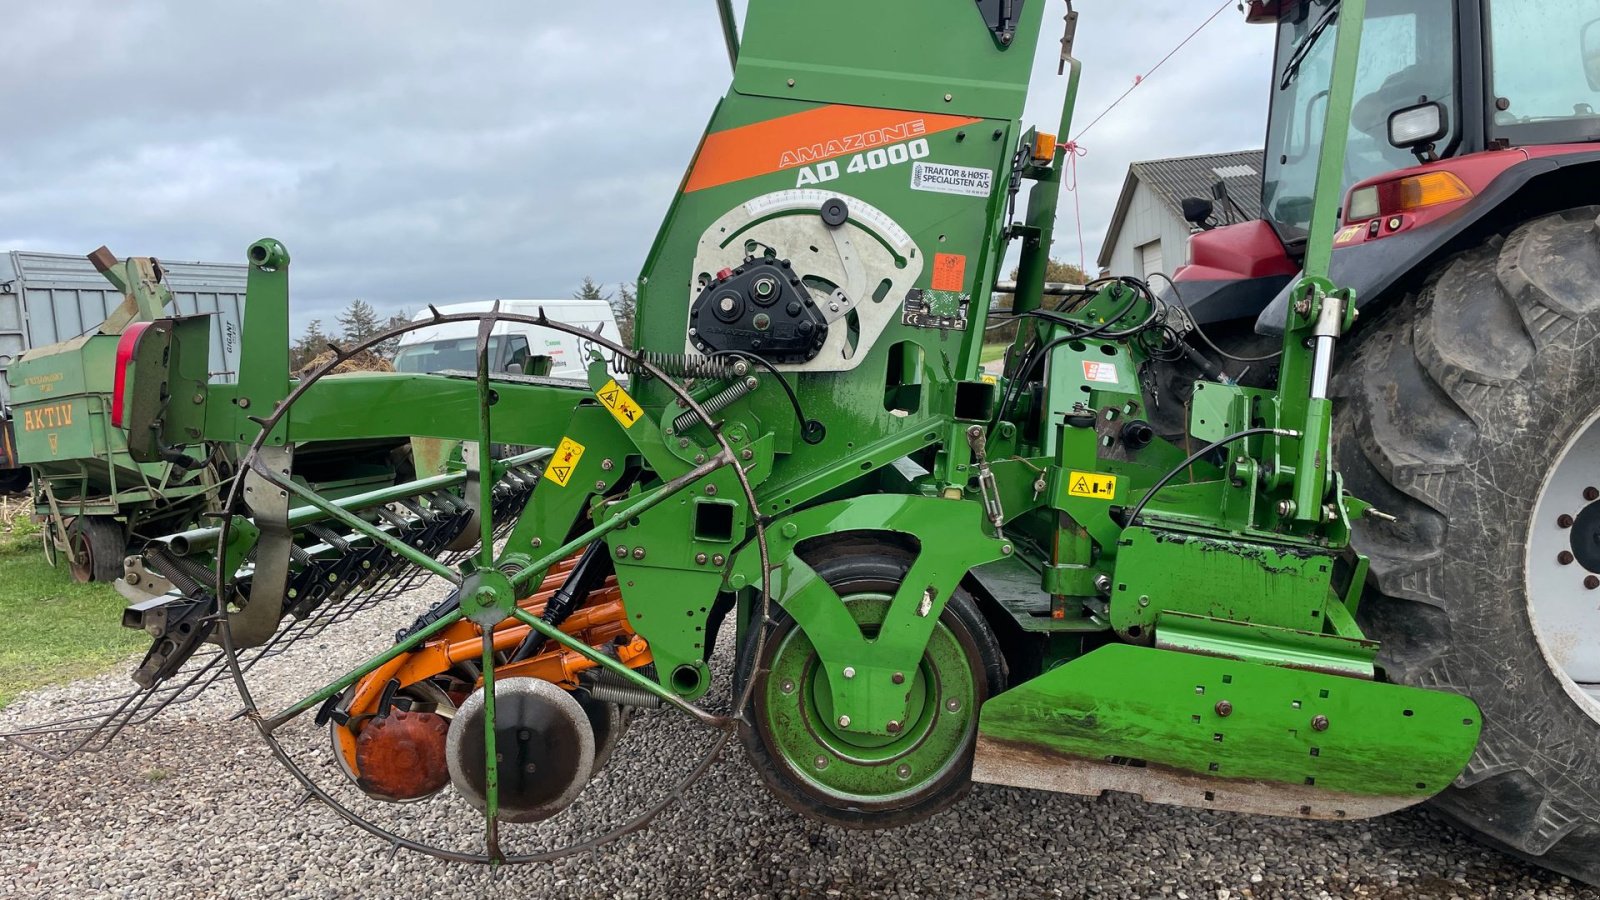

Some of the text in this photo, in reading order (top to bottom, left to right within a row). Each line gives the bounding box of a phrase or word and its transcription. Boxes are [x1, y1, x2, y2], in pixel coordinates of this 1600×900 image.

[779, 119, 926, 168] AMAZONE
[796, 138, 930, 188] AD 4000
[924, 166, 959, 177] TRAKTOR
[960, 170, 967, 178] &
[923, 175, 989, 188] SPECIALISTEN A/S
[24, 402, 73, 432] AKTIV
